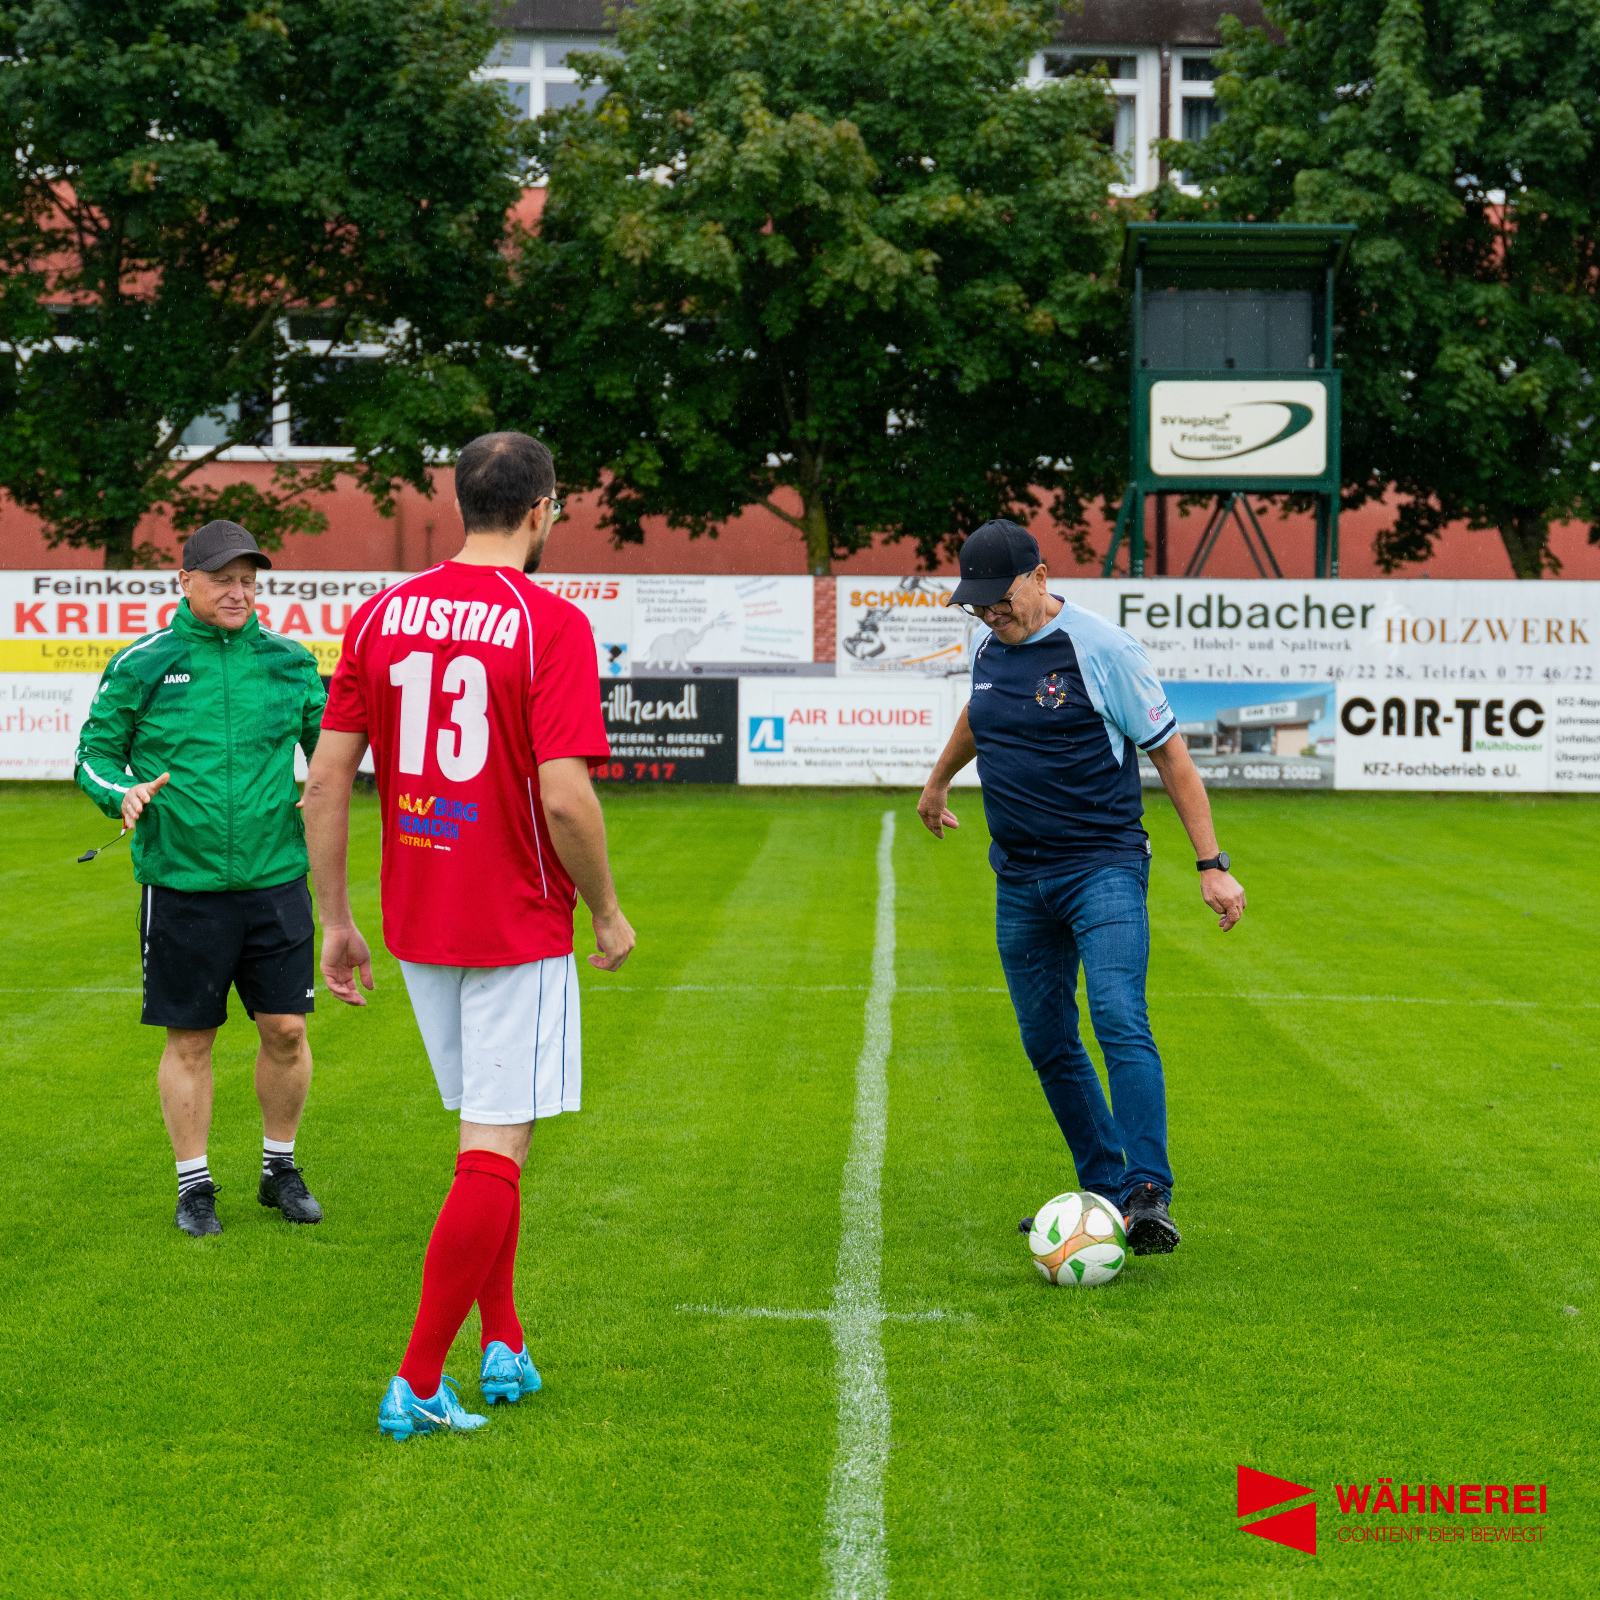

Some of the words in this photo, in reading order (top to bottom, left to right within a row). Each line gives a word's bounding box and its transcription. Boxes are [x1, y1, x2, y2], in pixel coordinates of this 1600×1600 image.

[34, 577, 179, 595] Feinkost
[1119, 594, 1376, 629] Feldbacher
[381, 596, 521, 650] AUSTRIA
[1386, 618, 1589, 644] HOLZWERK
[1248, 638, 1274, 650] und
[1281, 637, 1352, 652] Spaltwerk
[163, 674, 190, 684] JAKO
[1420, 664, 1487, 680] Telefax
[12, 686, 73, 704] Lösung
[601, 683, 698, 725] rillhendl
[0, 707, 72, 732] rbeit
[389, 651, 490, 782] 13
[788, 709, 827, 725] AIR
[838, 709, 932, 725] LIQUIDE
[1341, 697, 1545, 752] CAR-TEC
[666, 733, 724, 744] BIERZELT
[611, 746, 705, 758] ANSTALTUNGEN
[633, 762, 676, 779] 717
[845, 758, 864, 767] und
[1363, 763, 1486, 777] KFZ-Fachbetrieb
[1492, 764, 1521, 777] e.U.
[399, 813, 459, 840] HEMDEN
